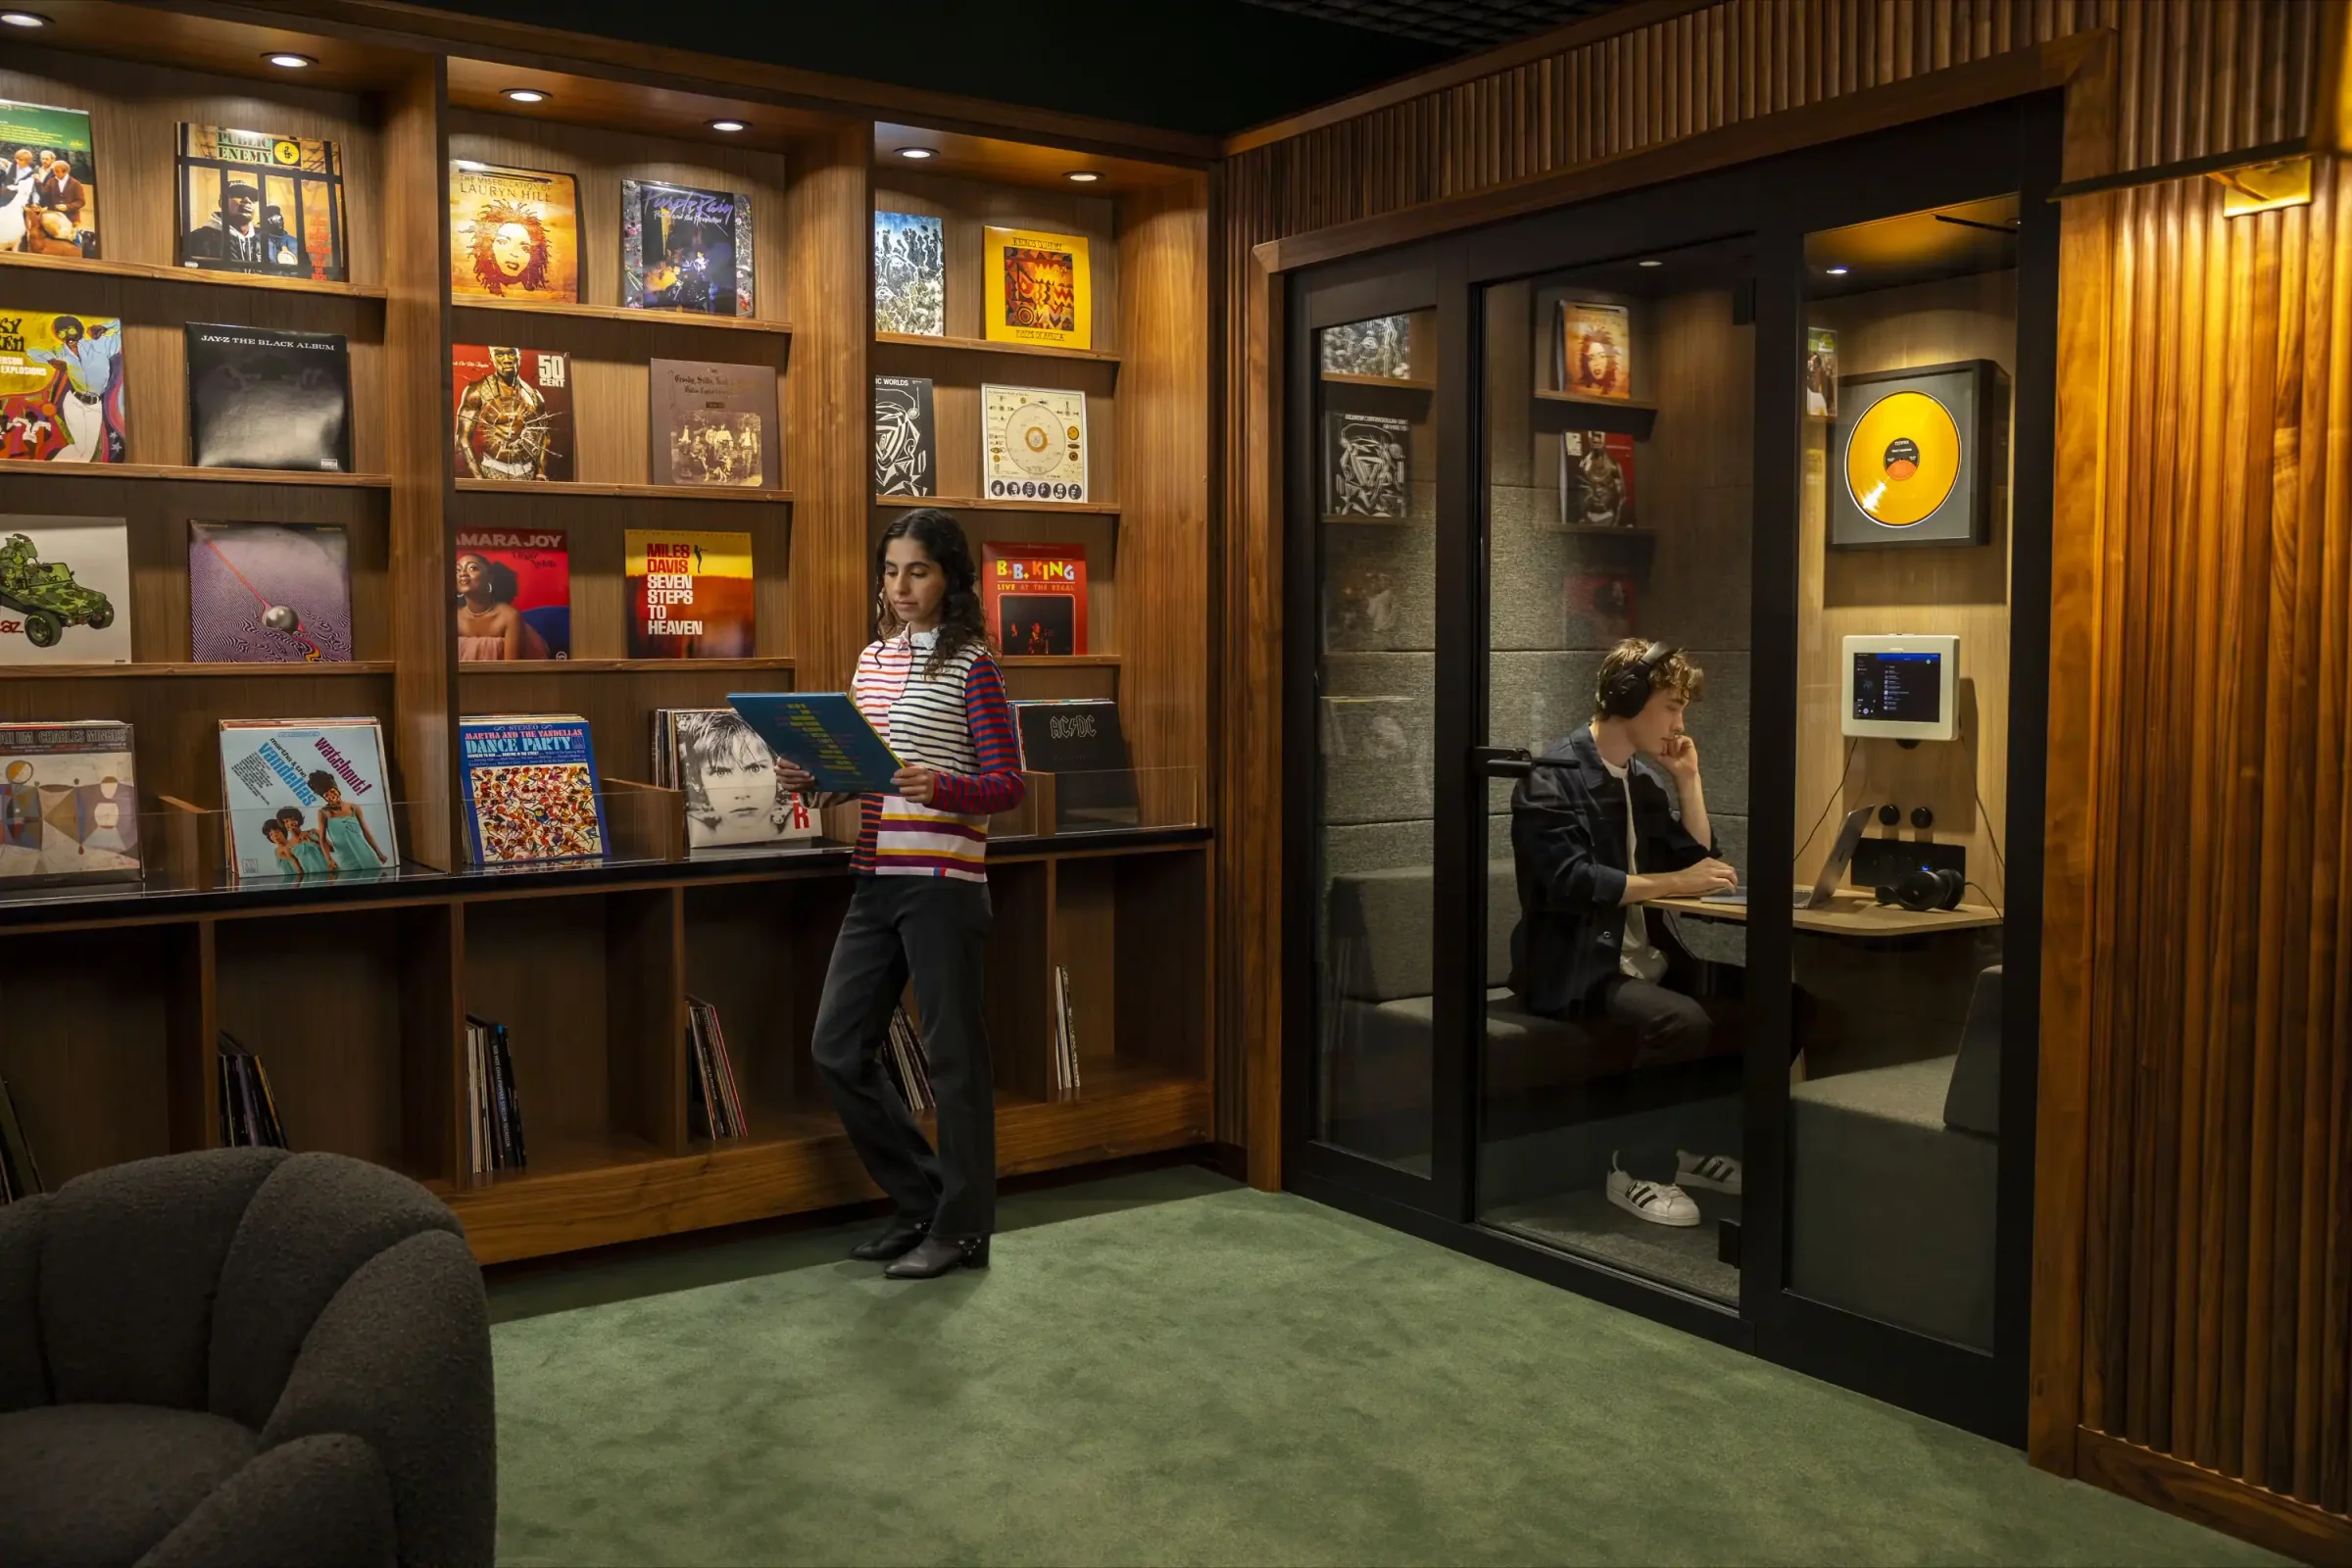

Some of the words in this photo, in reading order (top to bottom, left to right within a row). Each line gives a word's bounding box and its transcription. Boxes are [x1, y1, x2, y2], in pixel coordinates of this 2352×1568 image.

[218, 147, 271, 164] ENEMY
[460, 182, 515, 197] LAURYN
[521, 190, 552, 202] HILL
[643, 189, 698, 216] Purple
[696, 192, 734, 226] Rain
[258, 339, 294, 348] BLACK
[296, 342, 335, 351] ALBUM
[1, 365, 47, 376] EXPLOSIONS
[538, 354, 564, 379] 50
[539, 377, 565, 388] CENT
[523, 535, 563, 548] JOY
[647, 543, 691, 558] MILES
[647, 559, 688, 573] DAVIS
[1032, 560, 1075, 580] KING
[647, 574, 693, 589] SEVEN
[647, 589, 694, 605] STEPS
[648, 605, 667, 619] TO
[648, 620, 703, 635] HEAVEN
[16, 731, 33, 744] UM
[39, 730, 85, 744] CHARLES
[86, 729, 126, 742] MINGUS
[465, 731, 501, 740] MARTHA
[465, 738, 518, 754] DANCE
[521, 737, 570, 752] PARTY
[270, 738, 293, 763] martha
[295, 765, 307, 778] the
[314, 737, 372, 796] watchout!
[258, 742, 318, 807] vandellas
